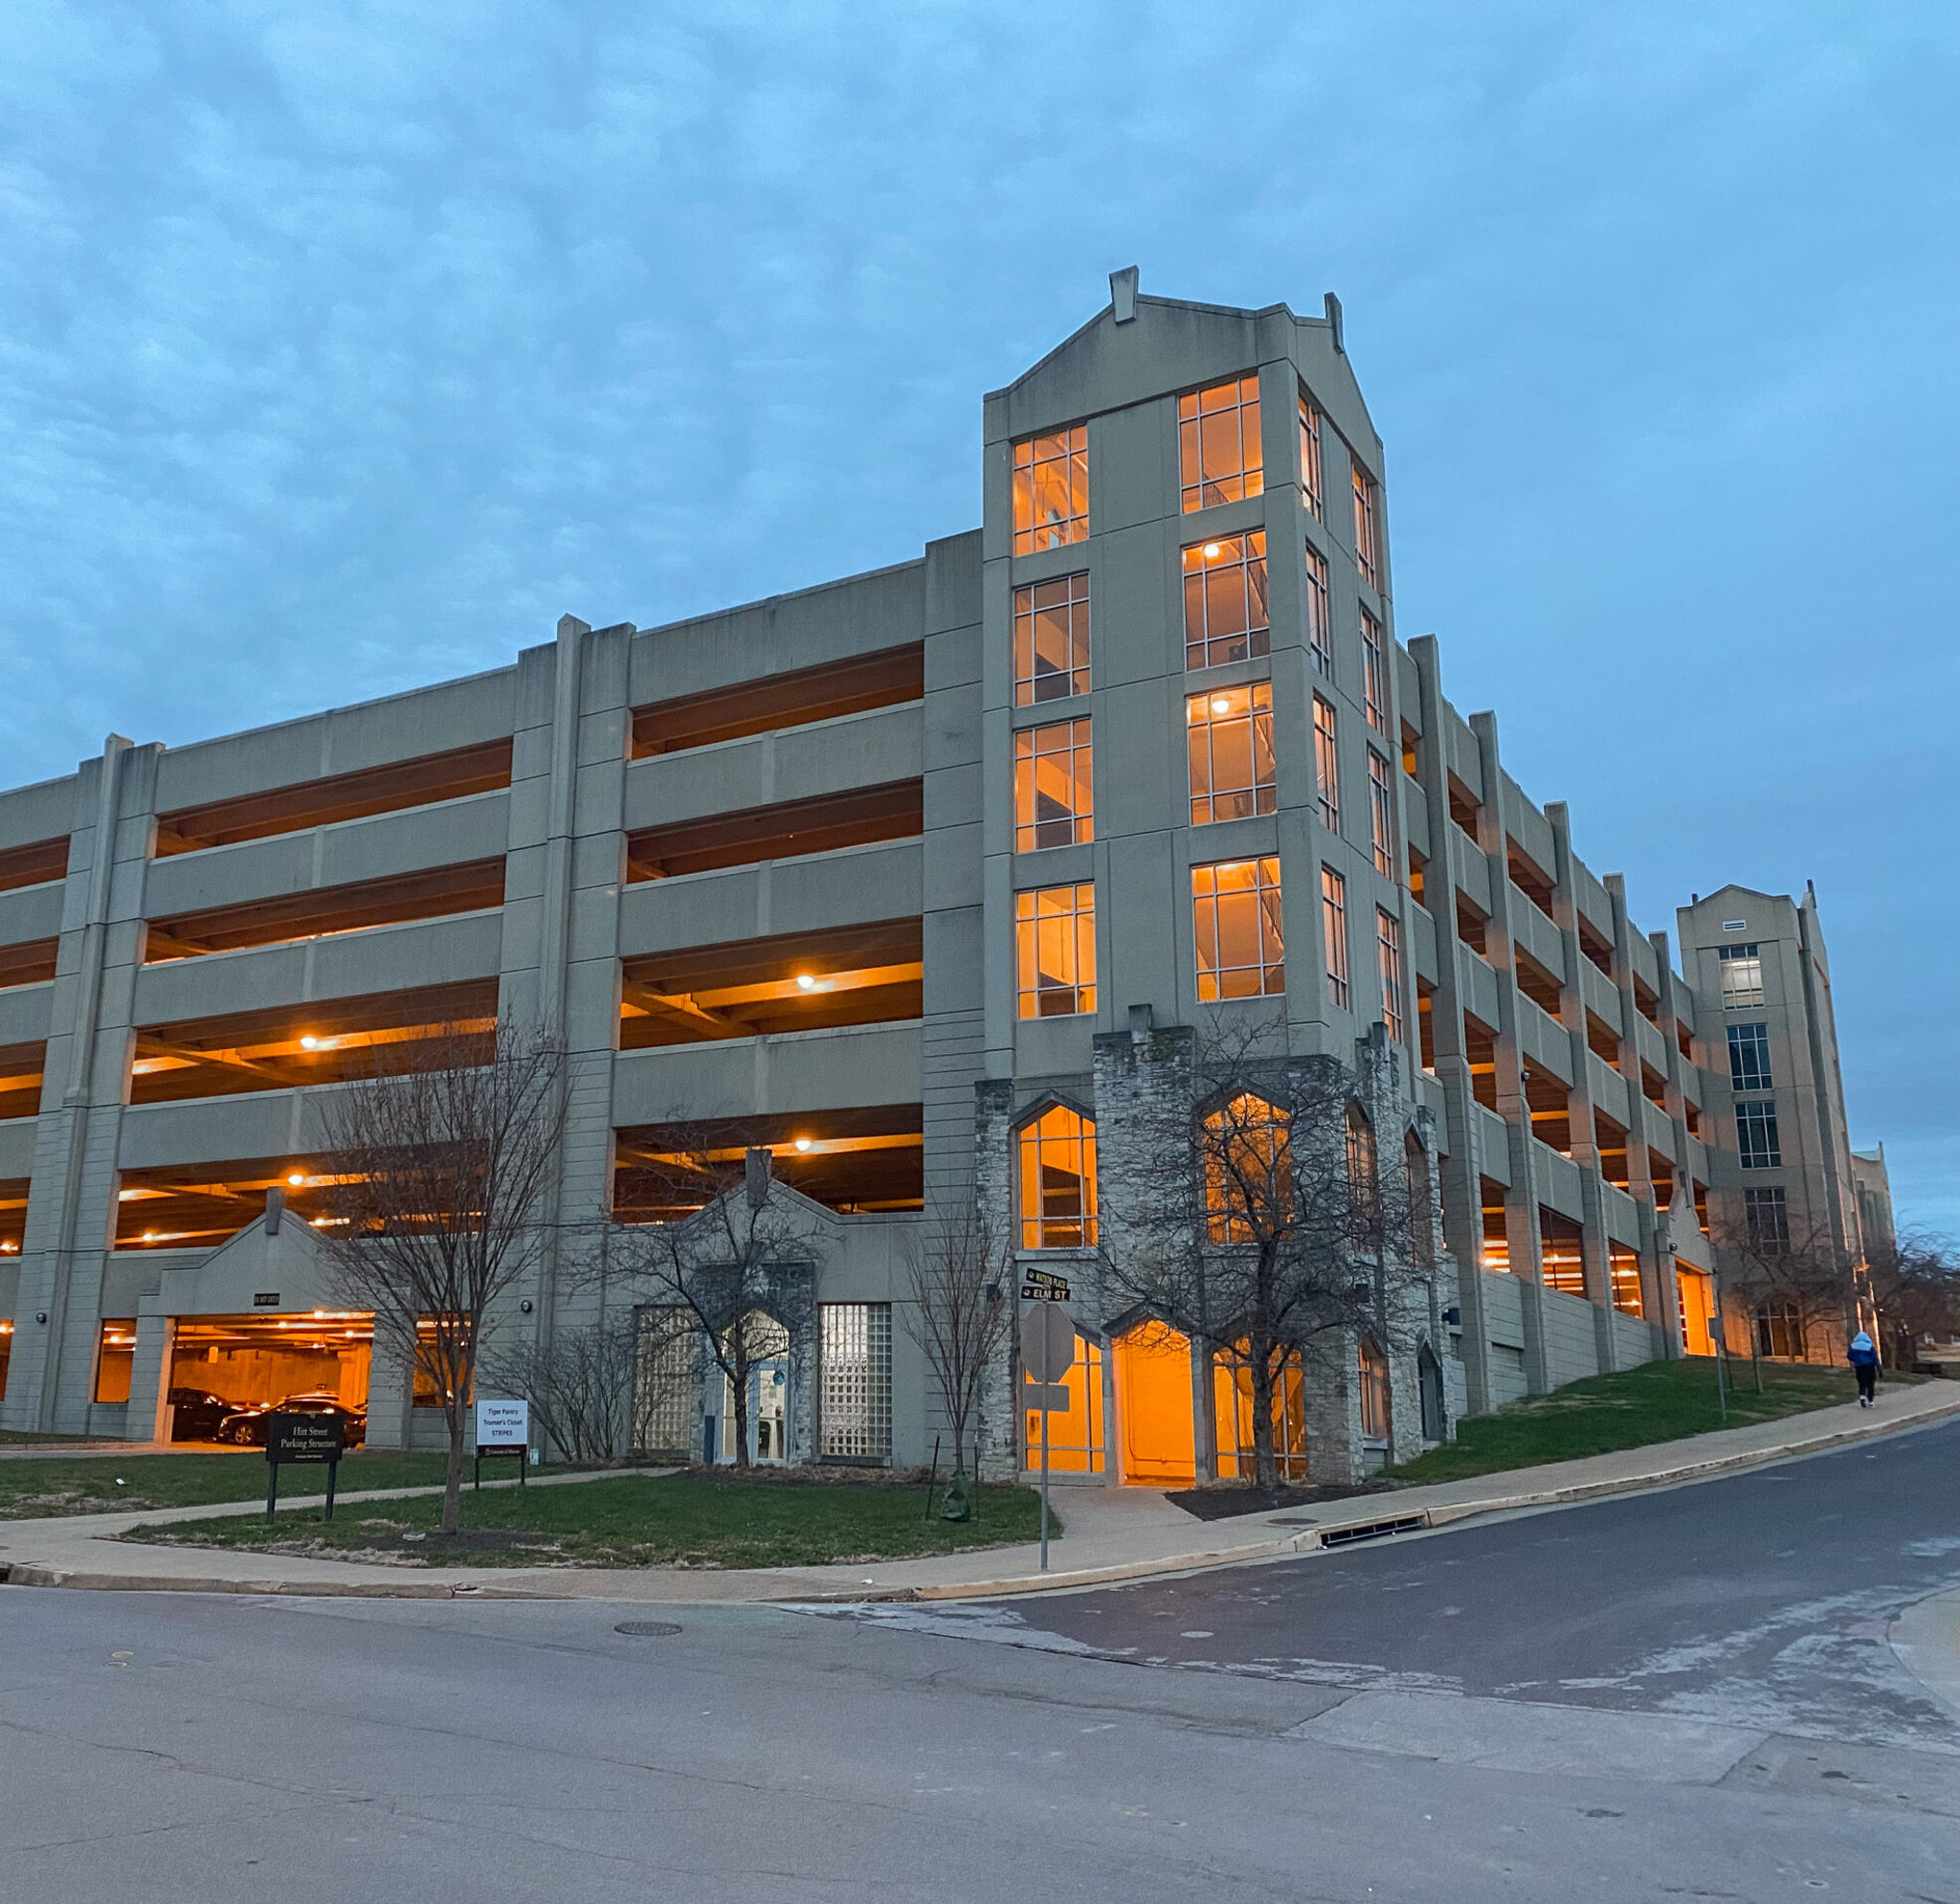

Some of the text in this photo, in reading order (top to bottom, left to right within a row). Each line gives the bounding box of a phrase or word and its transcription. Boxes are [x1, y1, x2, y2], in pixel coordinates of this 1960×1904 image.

[1034, 1288, 1067, 1300] ELM ST
[293, 1426, 328, 1436] Hitt Street
[281, 1439, 336, 1450] Parking Structure
